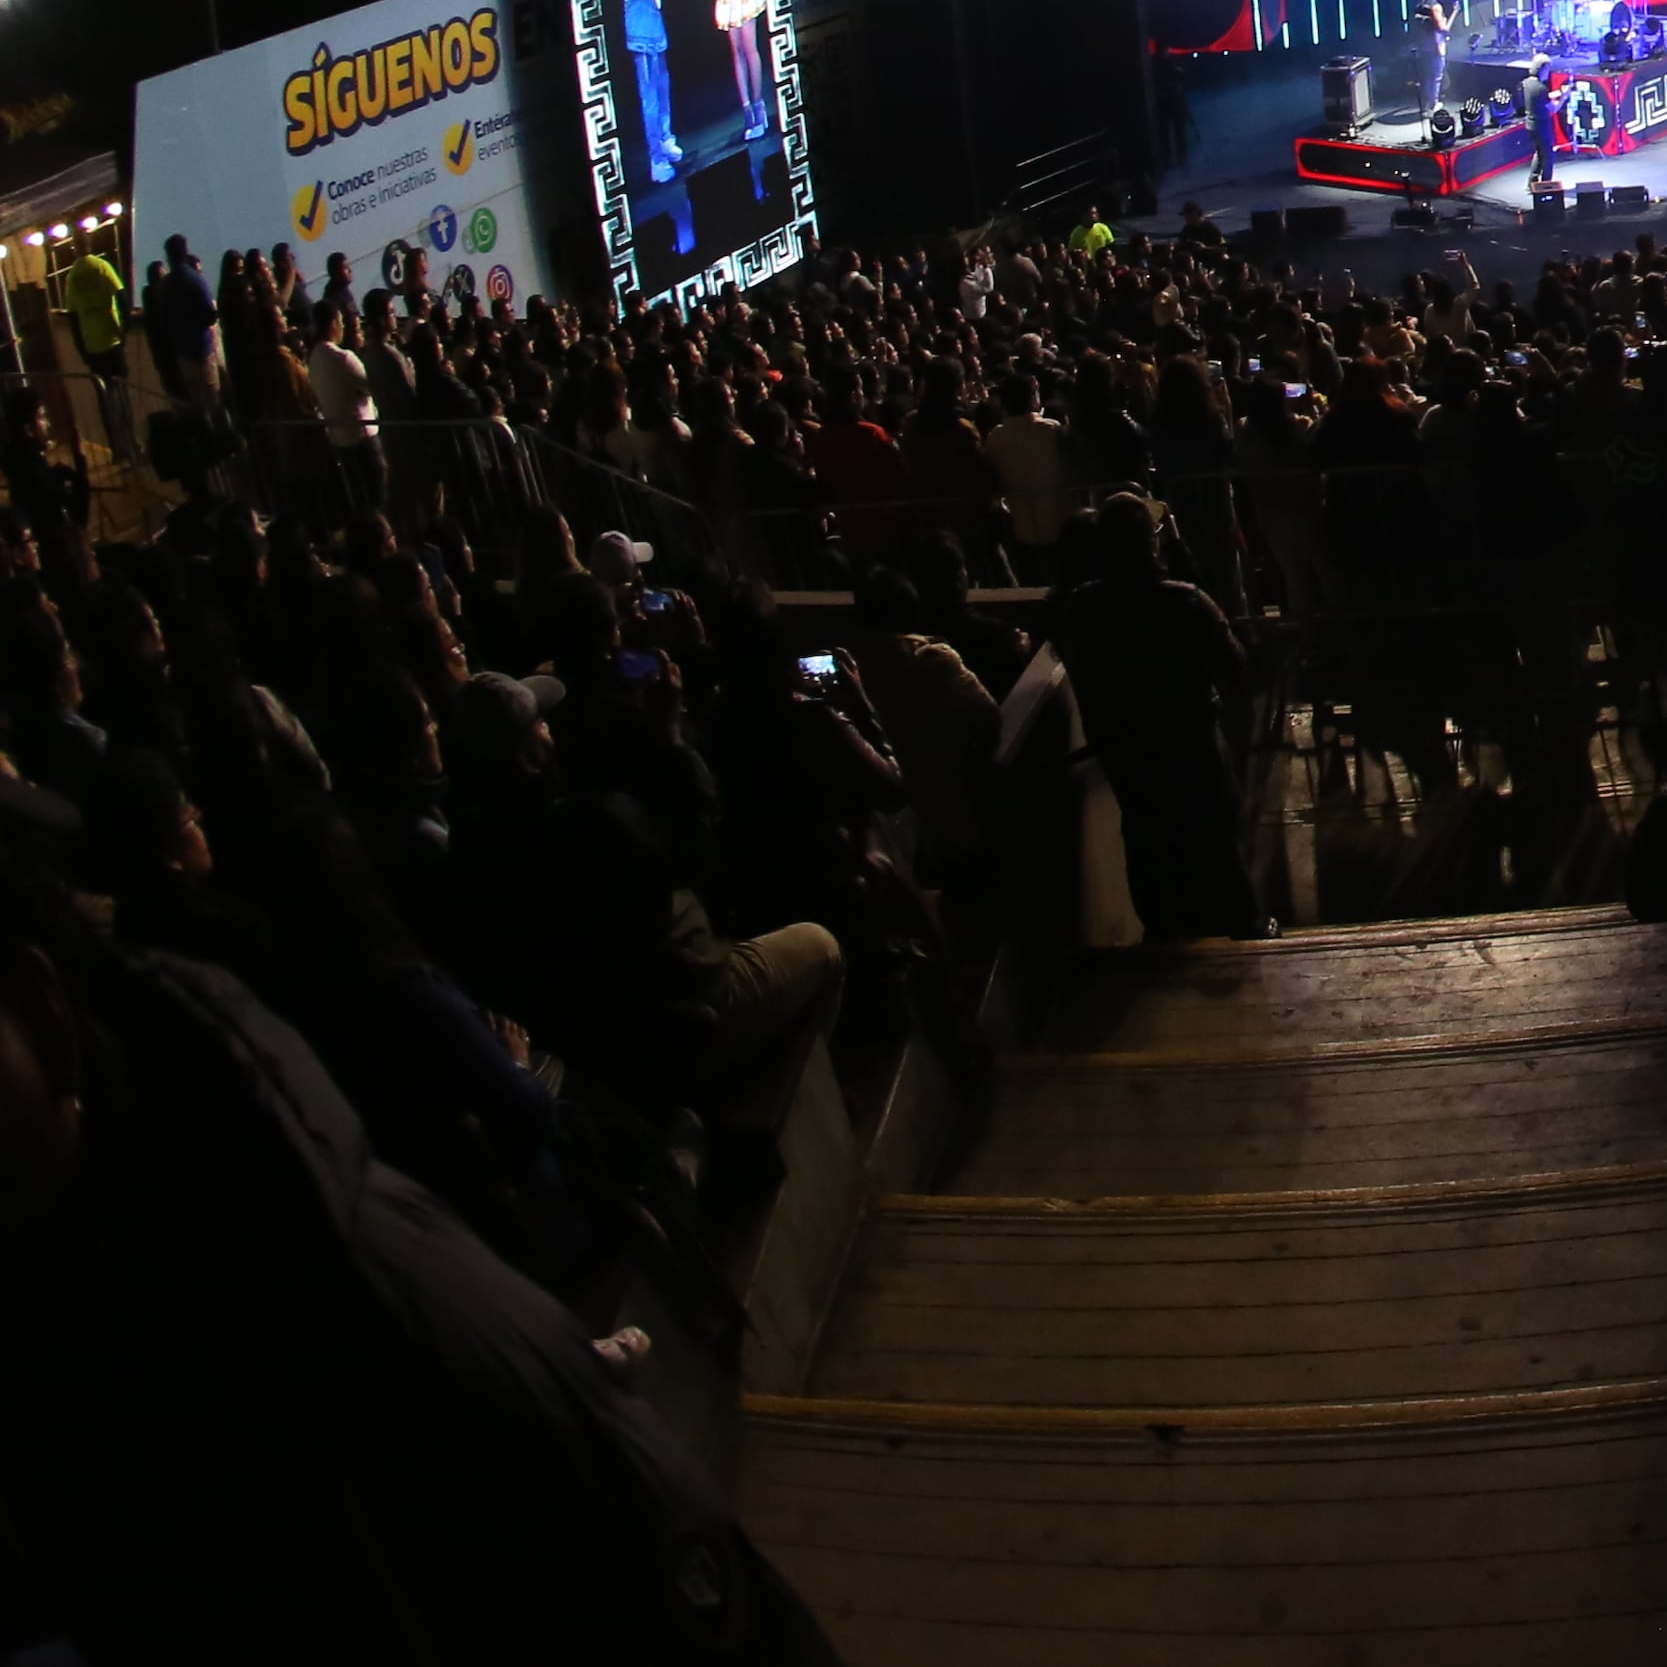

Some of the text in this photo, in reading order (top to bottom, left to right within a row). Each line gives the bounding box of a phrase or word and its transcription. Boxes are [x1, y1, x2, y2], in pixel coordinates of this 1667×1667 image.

[284, 8, 500, 157] SÍGUENOS
[327, 146, 429, 200] Conoce nuestras
[331, 165, 437, 225] obras e iniciativas
